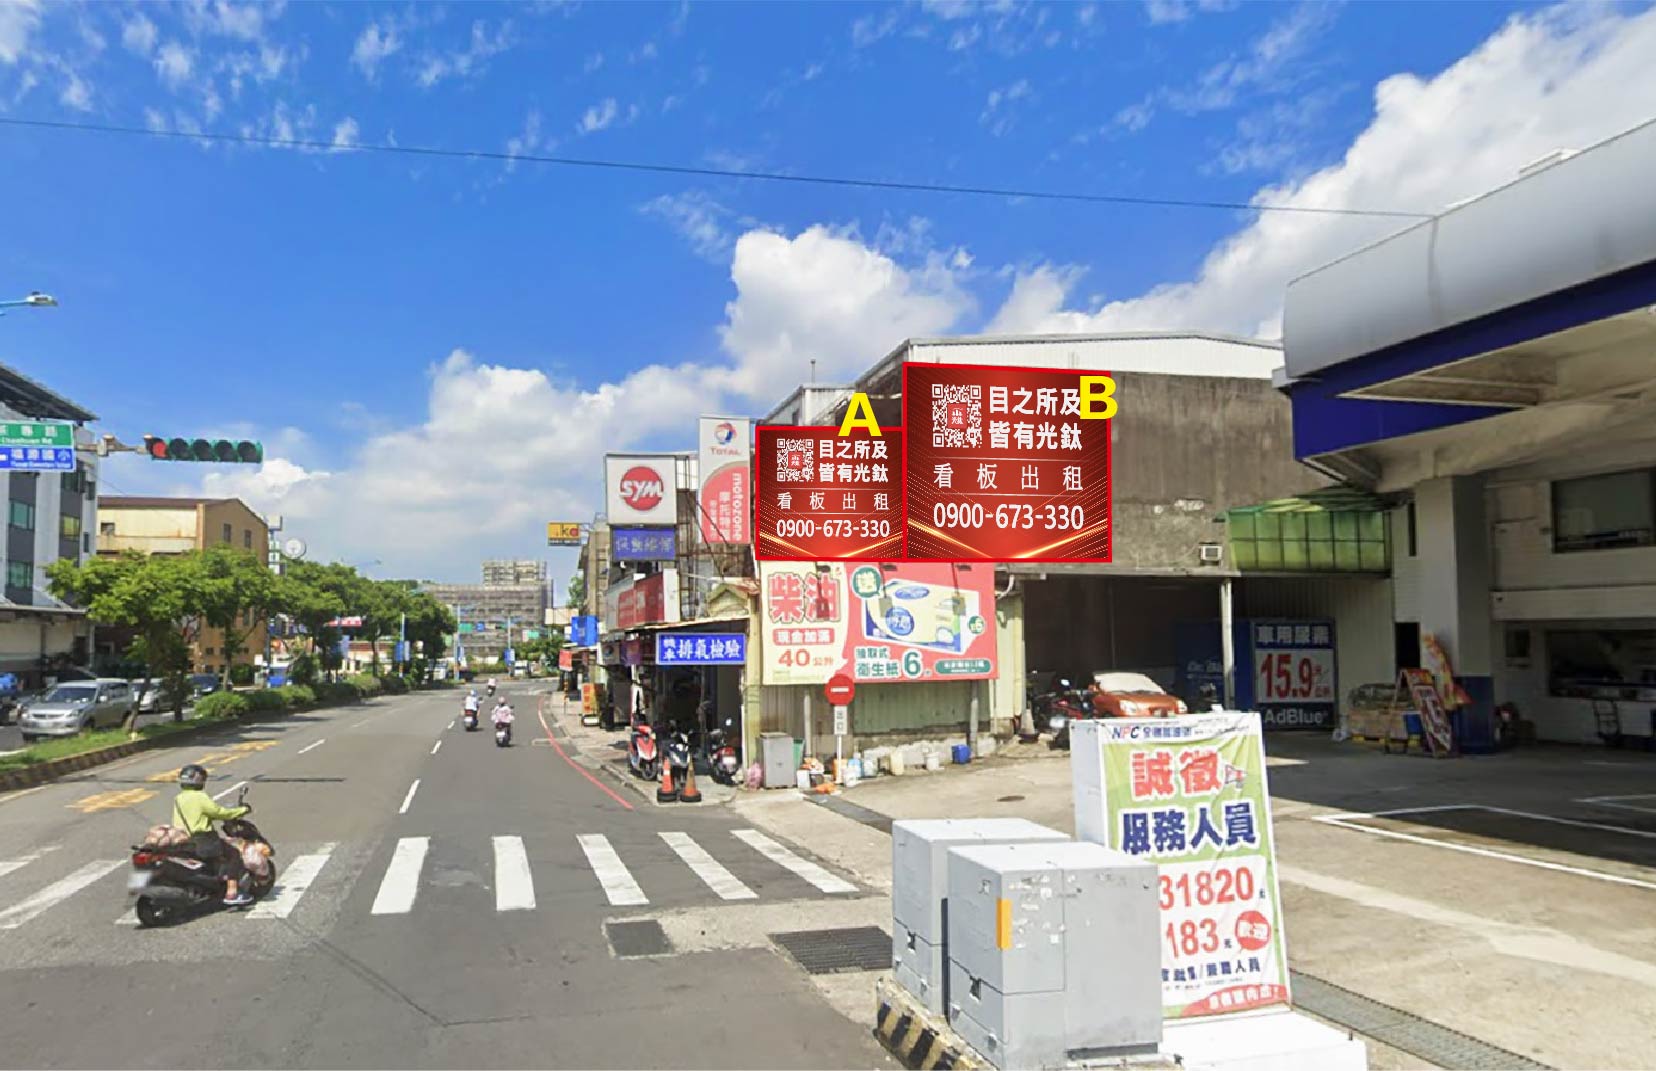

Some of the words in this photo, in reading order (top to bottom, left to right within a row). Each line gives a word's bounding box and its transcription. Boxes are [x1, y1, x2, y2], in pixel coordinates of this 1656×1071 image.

[989, 387, 1081, 416] 目之所及
[989, 421, 1083, 450] 皆有光鈦
[818, 440, 889, 460] 目之所及
[818, 462, 889, 483] 皆有光鈦
[934, 462, 1083, 491] 看板出租
[619, 480, 663, 502] SYM
[777, 491, 890, 511] 看板出租
[776, 518, 890, 538] 0900-673-330
[933, 502, 1084, 531] 0900-673-330
[769, 573, 840, 622] 柴油
[677, 638, 741, 660] 排氣檢驗
[778, 648, 810, 667] 40
[856, 662, 899, 678] 衛生紙
[903, 651, 921, 677] 6
[1261, 653, 1313, 698] 15.9
[1112, 726, 1140, 739] NPC
[1131, 750, 1222, 797] 誠徵
[1122, 802, 1257, 855] 服務人員
[1166, 918, 1220, 958] 183
